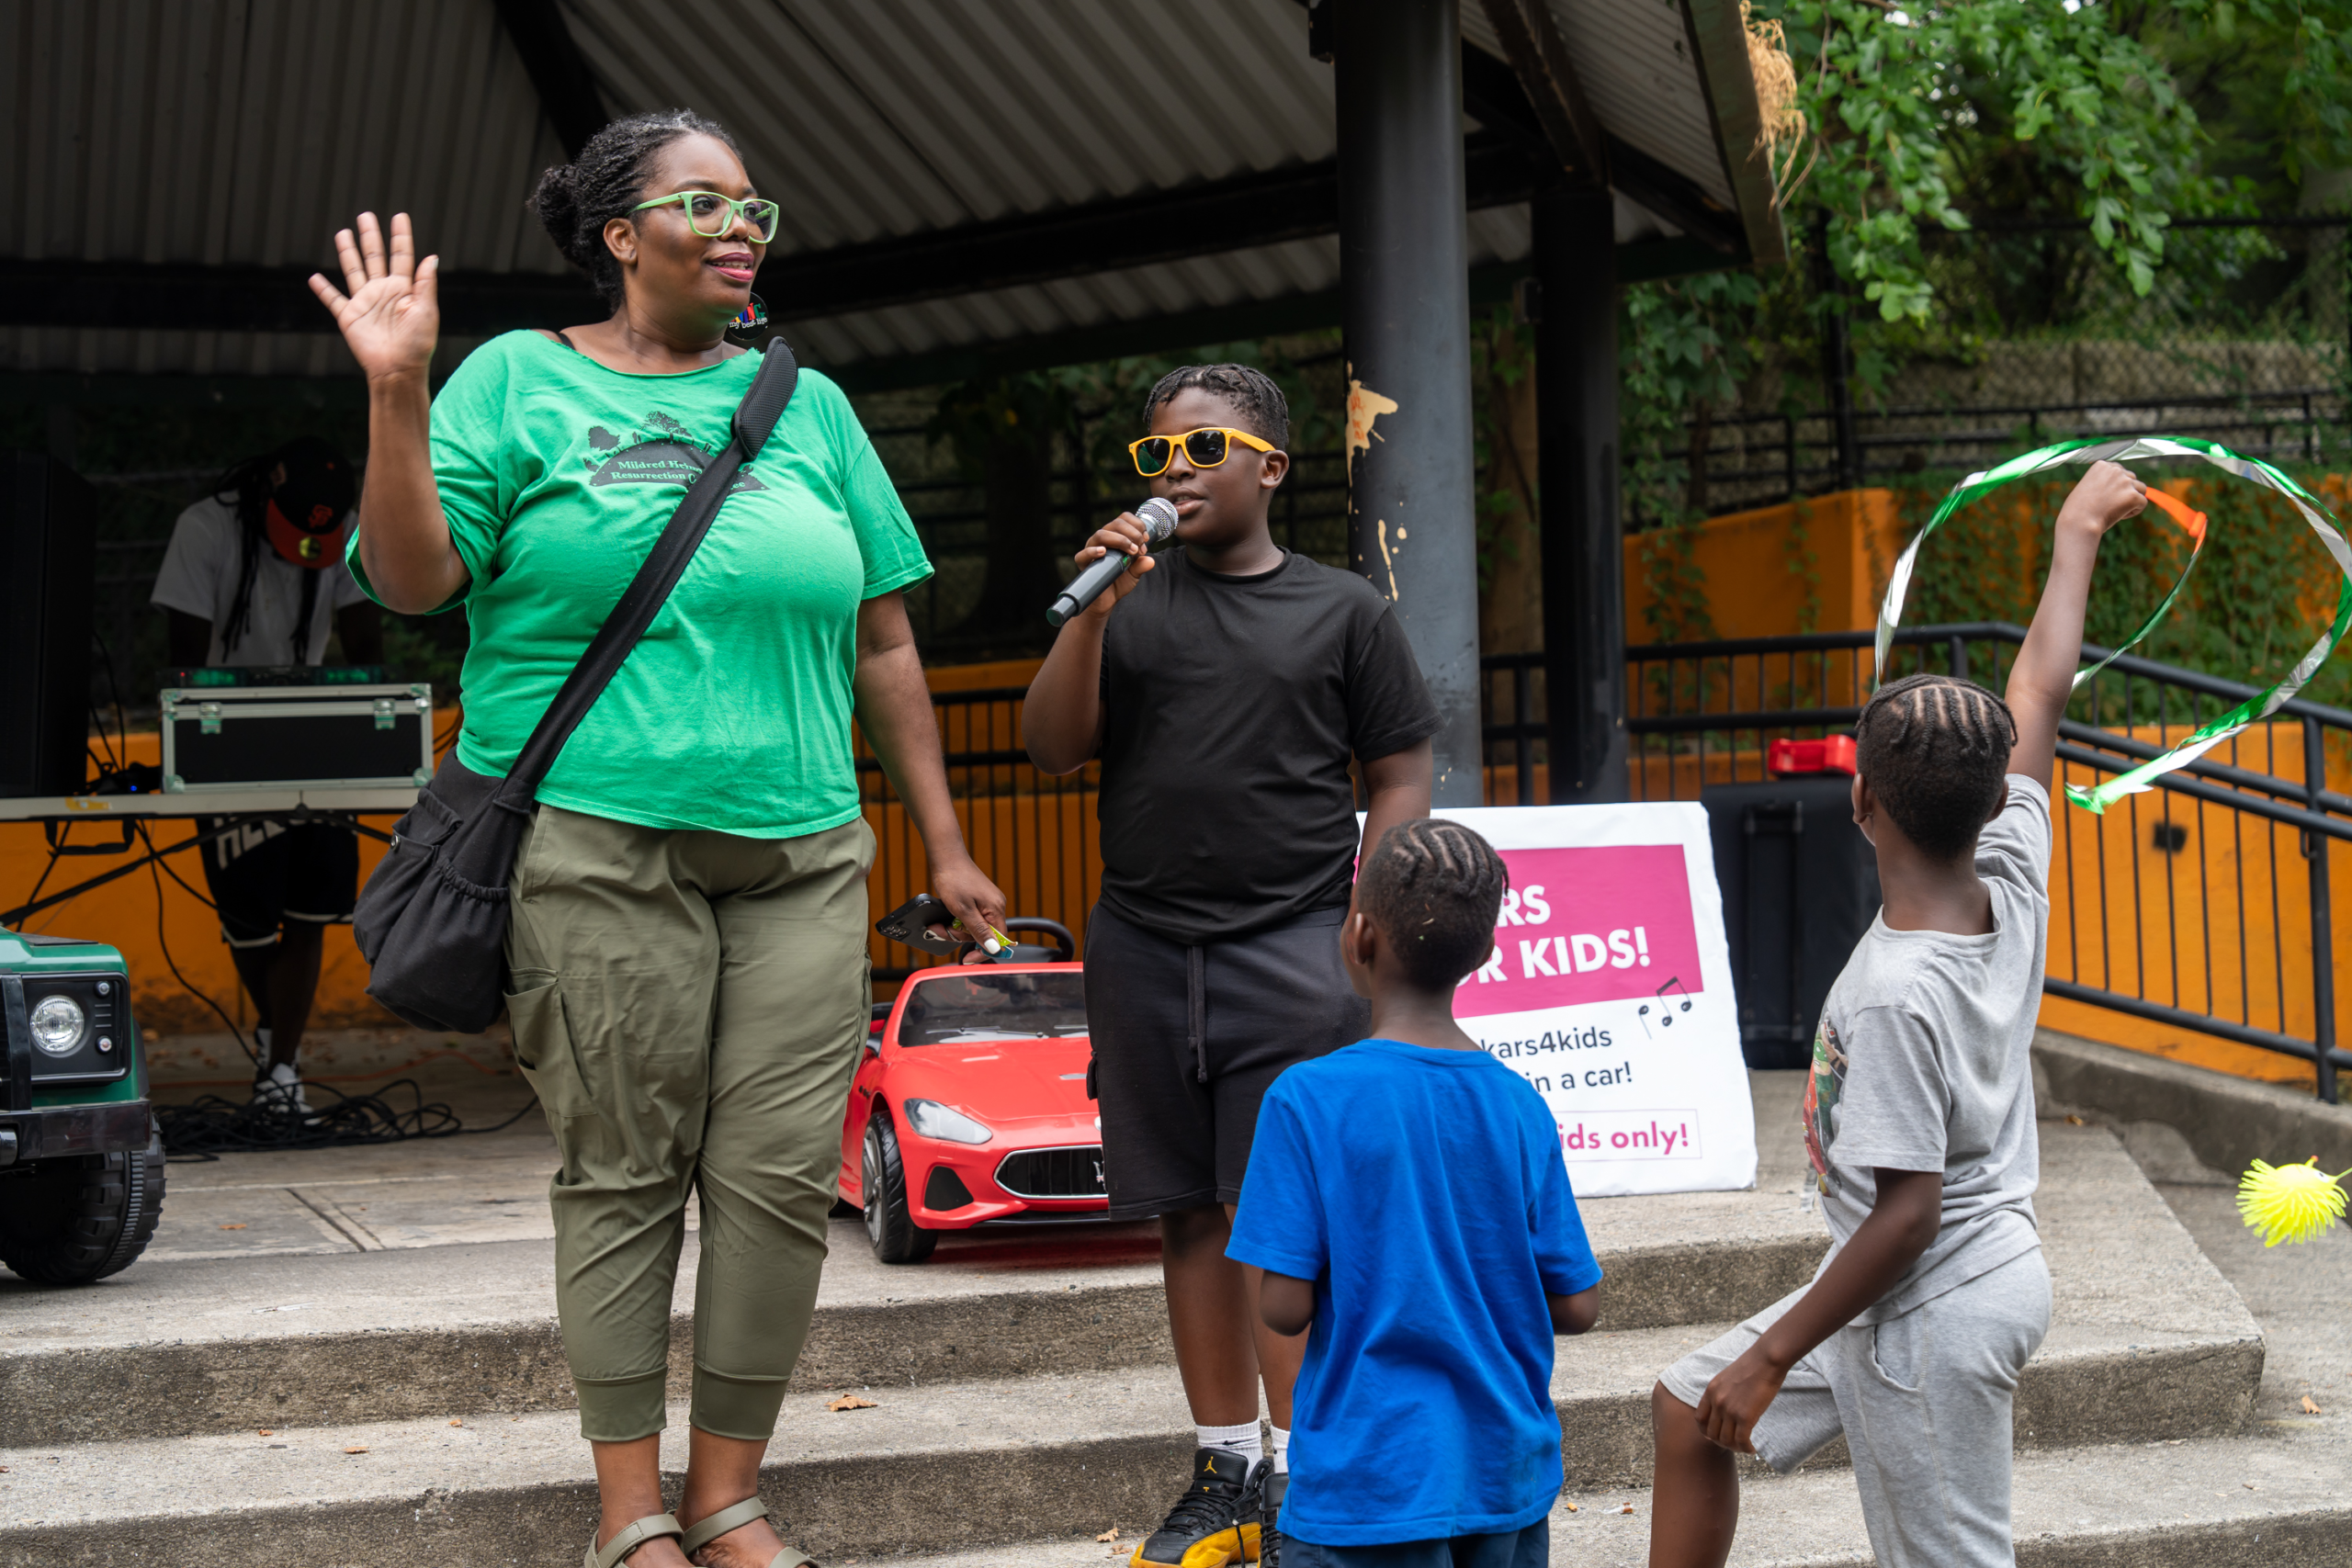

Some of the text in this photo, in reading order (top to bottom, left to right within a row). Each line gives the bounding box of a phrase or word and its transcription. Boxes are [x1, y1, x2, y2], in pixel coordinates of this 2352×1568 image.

[741, 320, 756, 329] best
[756, 317, 768, 325] life
[610, 471, 686, 479] Resurrection
[617, 460, 666, 469] Mildred
[1497, 885, 1551, 928] RS
[1519, 926, 1651, 979] KIDS!
[1481, 1026, 1612, 1059] kars4kids
[1561, 1073, 1576, 1089] a
[1585, 1061, 1633, 1087] car!
[1559, 1121, 1688, 1155] ids only!
